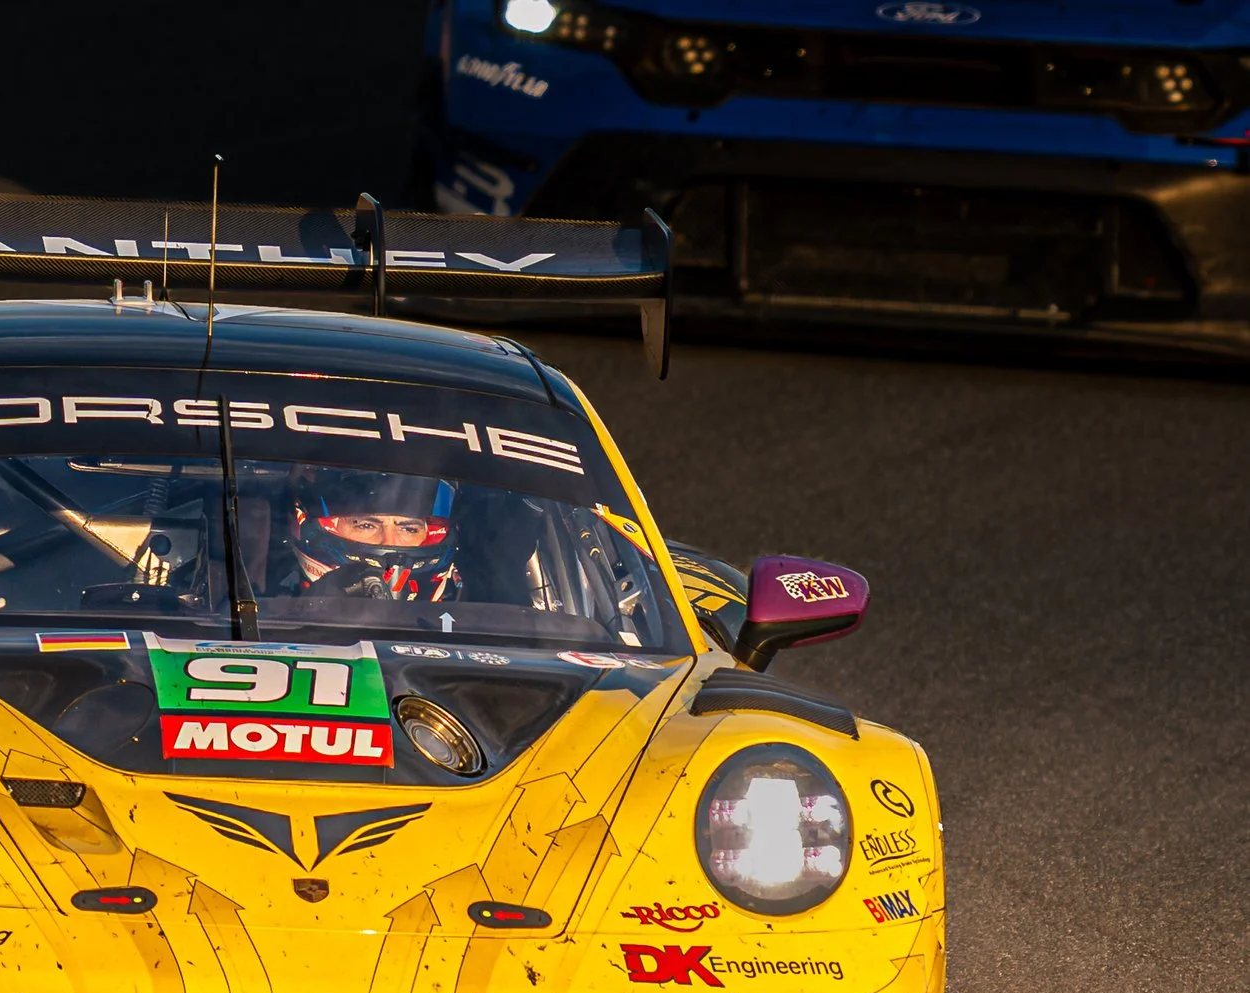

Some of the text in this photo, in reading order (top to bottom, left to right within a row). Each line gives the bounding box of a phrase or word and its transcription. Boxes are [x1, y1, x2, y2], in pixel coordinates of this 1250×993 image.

[187, 656, 351, 707] 91
[174, 722, 385, 759] MOTUL
[859, 828, 916, 861] ENDLESS
[630, 902, 720, 933] Ricco
[863, 890, 920, 923] BiMAX
[619, 943, 844, 988] DK Engineering
